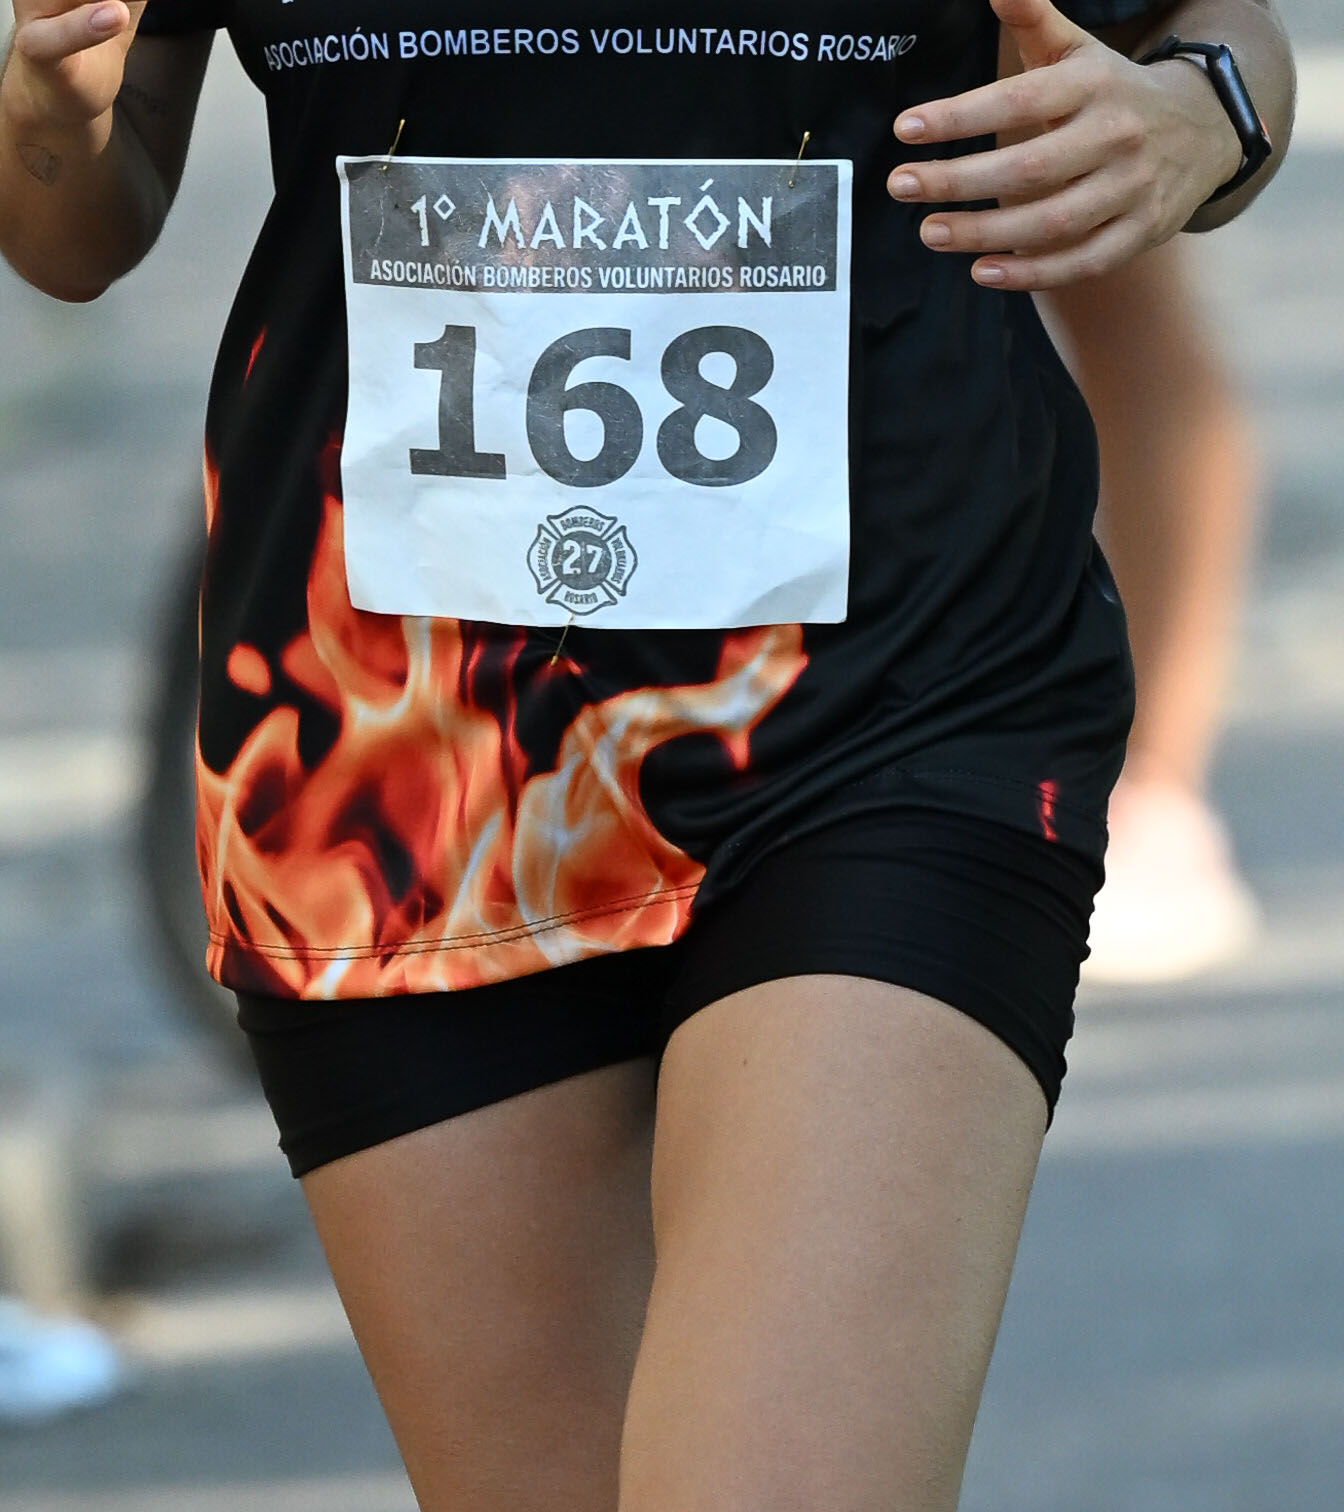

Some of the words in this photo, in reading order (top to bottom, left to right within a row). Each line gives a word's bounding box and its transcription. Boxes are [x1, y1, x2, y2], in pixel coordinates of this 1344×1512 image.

[263, 26, 390, 71] ASOCIACIÓN
[399, 28, 580, 59] BOMBEROS
[590, 28, 809, 61] VOLUNTARIOS
[817, 34, 917, 61] ROSARIO
[478, 178, 772, 251] MARATÓN
[370, 258, 476, 287] ASOCIACIÓN
[483, 266, 592, 289] BOMBEROS
[598, 265, 734, 289] VOLUNTARIOS
[740, 265, 826, 288] ROSARIO
[408, 324, 778, 488] 168
[562, 539, 603, 575] 27
